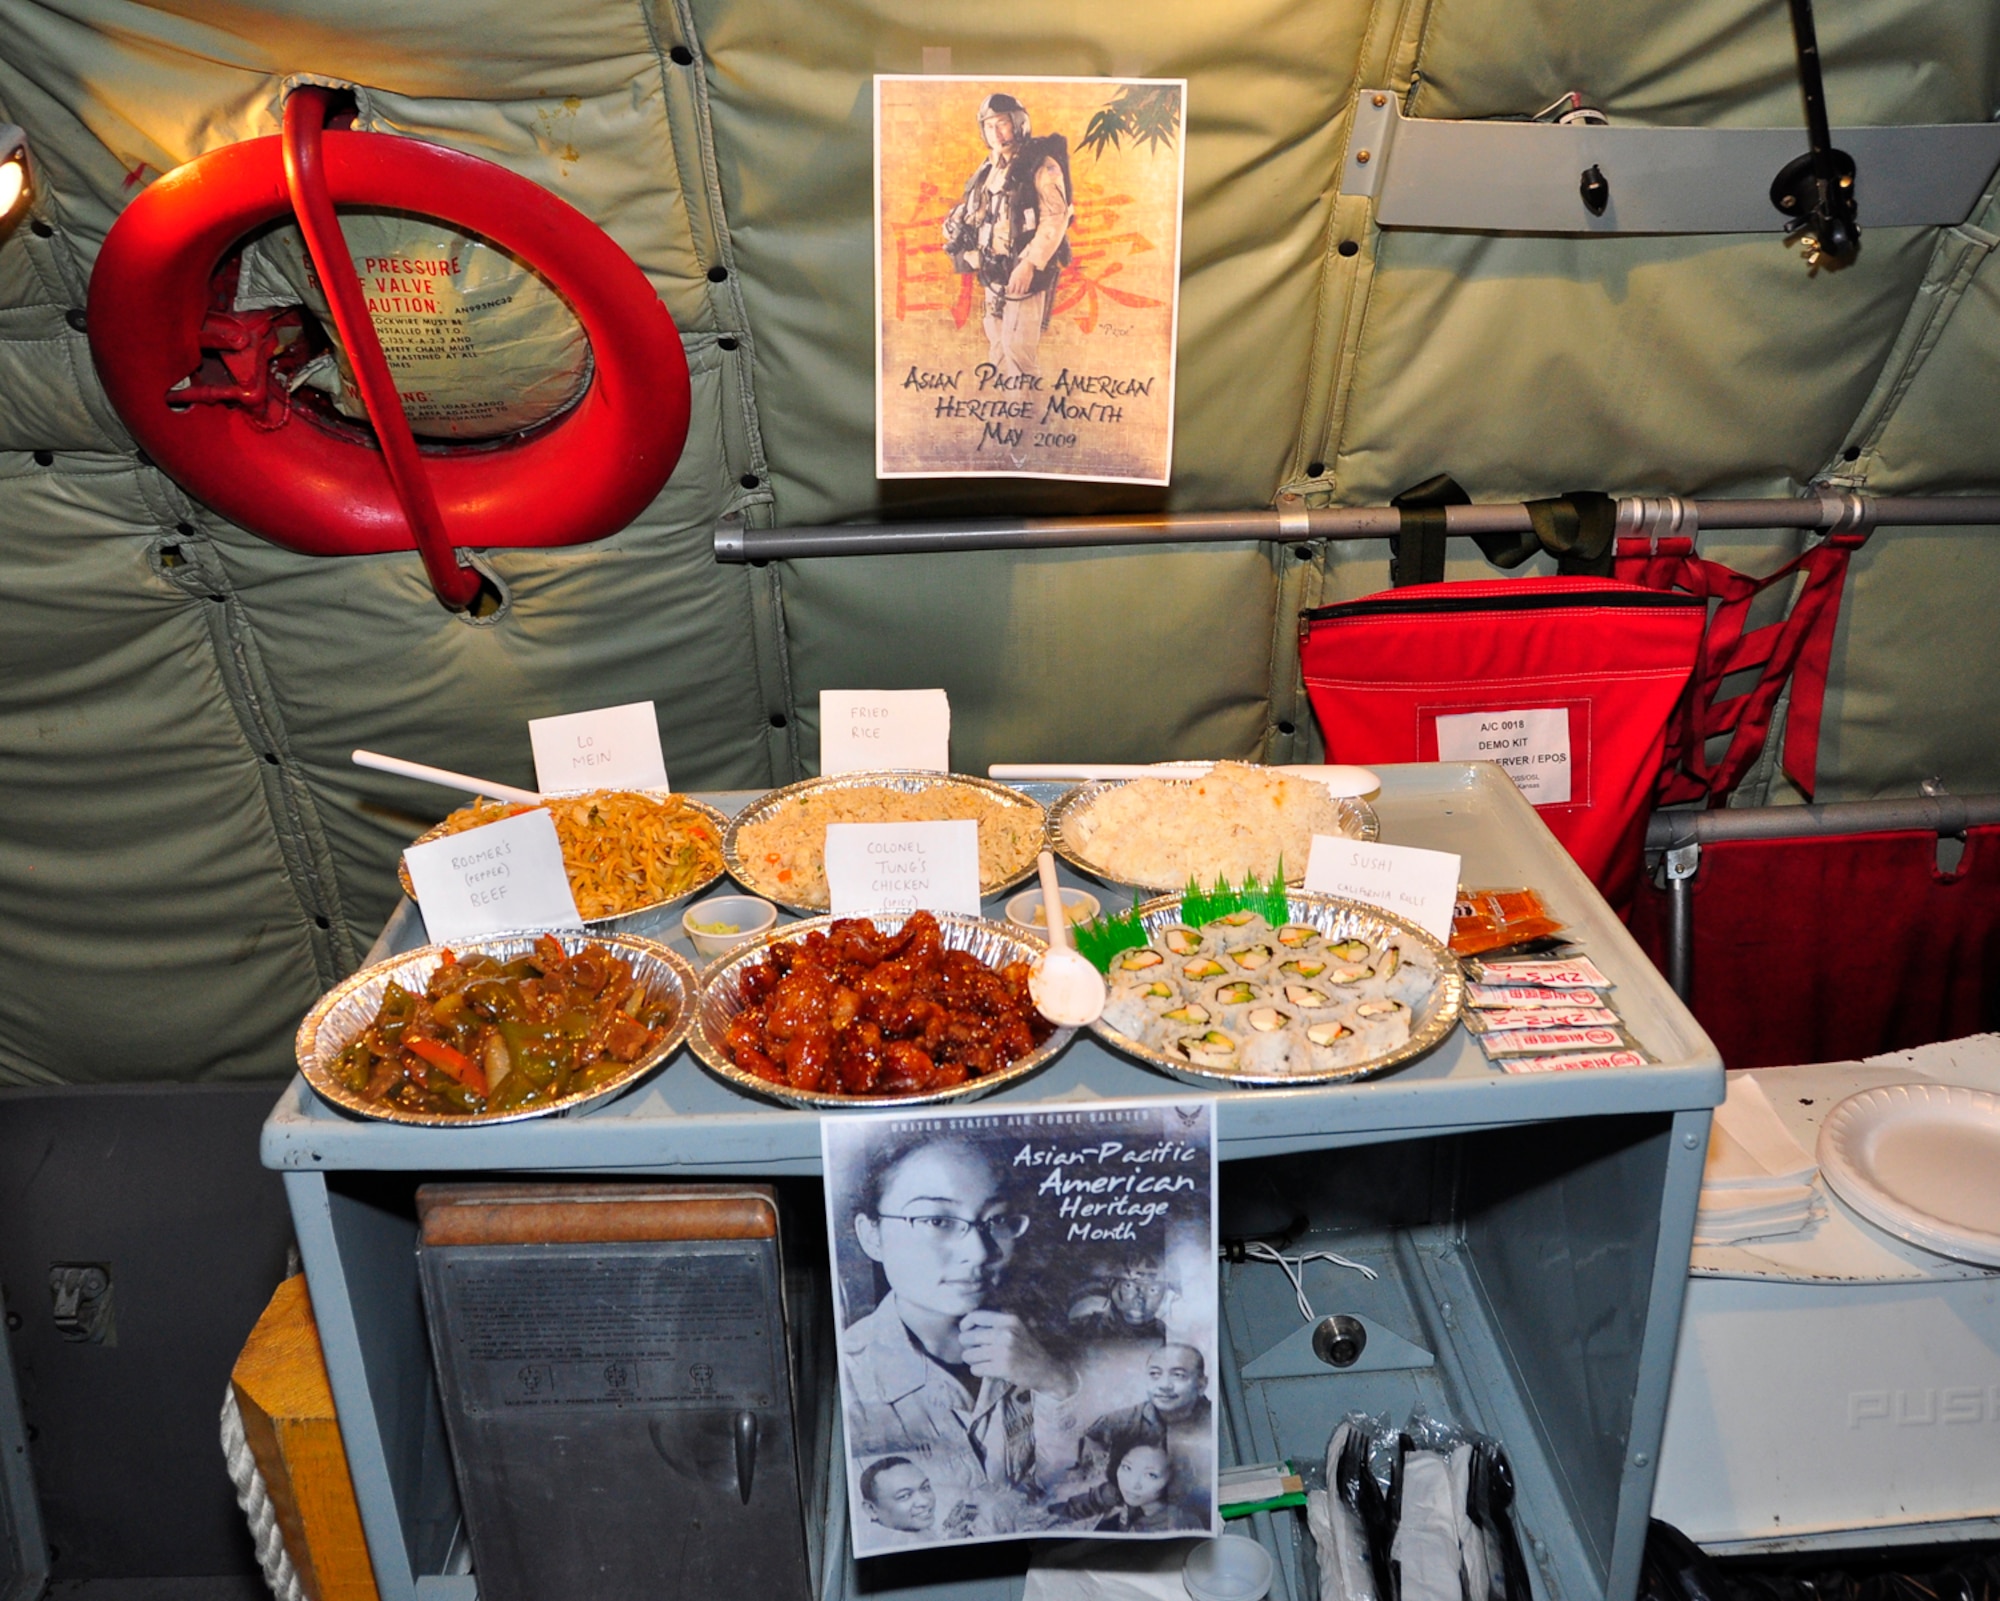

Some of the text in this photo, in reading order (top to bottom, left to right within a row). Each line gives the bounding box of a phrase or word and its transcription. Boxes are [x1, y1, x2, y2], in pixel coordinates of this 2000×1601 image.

[365, 257, 461, 276] PRESSURE
[375, 277, 434, 294] VALVE
[368, 298, 443, 314] AUTION:
[374, 317, 418, 325] OCKWIRE
[422, 318, 448, 326] MUST
[376, 327, 421, 335] NSTALLED
[900, 362, 1155, 398] ASIAN PACIFIC AMERICAN
[935, 395, 1124, 425] HERITAGE MONTH
[977, 421, 1076, 450] MAY 2009
[851, 706, 889, 719] FRIED
[851, 726, 881, 739] RICE
[1480, 720, 1525, 732] A/C 0018
[577, 735, 594, 749] LO
[1478, 737, 1528, 750] DEMO KIT
[572, 749, 611, 769] MEIN
[1537, 752, 1567, 764] EPOS
[867, 842, 926, 854] COLONEL
[875, 858, 927, 874] TUNG'S
[1350, 853, 1393, 873] SUSHI
[871, 879, 930, 891] CHICKEN
[1337, 882, 1392, 901] CALIFORNIA
[470, 886, 509, 908] BEEF
[890, 1121, 942, 1133] UNITED
[949, 1117, 1000, 1130] STATES
[1007, 1115, 1031, 1127] AIR
[1039, 1113, 1081, 1125] FORCE
[1013, 1141, 1196, 1167] Asian-Pacific
[1037, 1166, 1196, 1196] American
[1059, 1194, 1169, 1226] Heritage
[1067, 1222, 1137, 1242] Month
